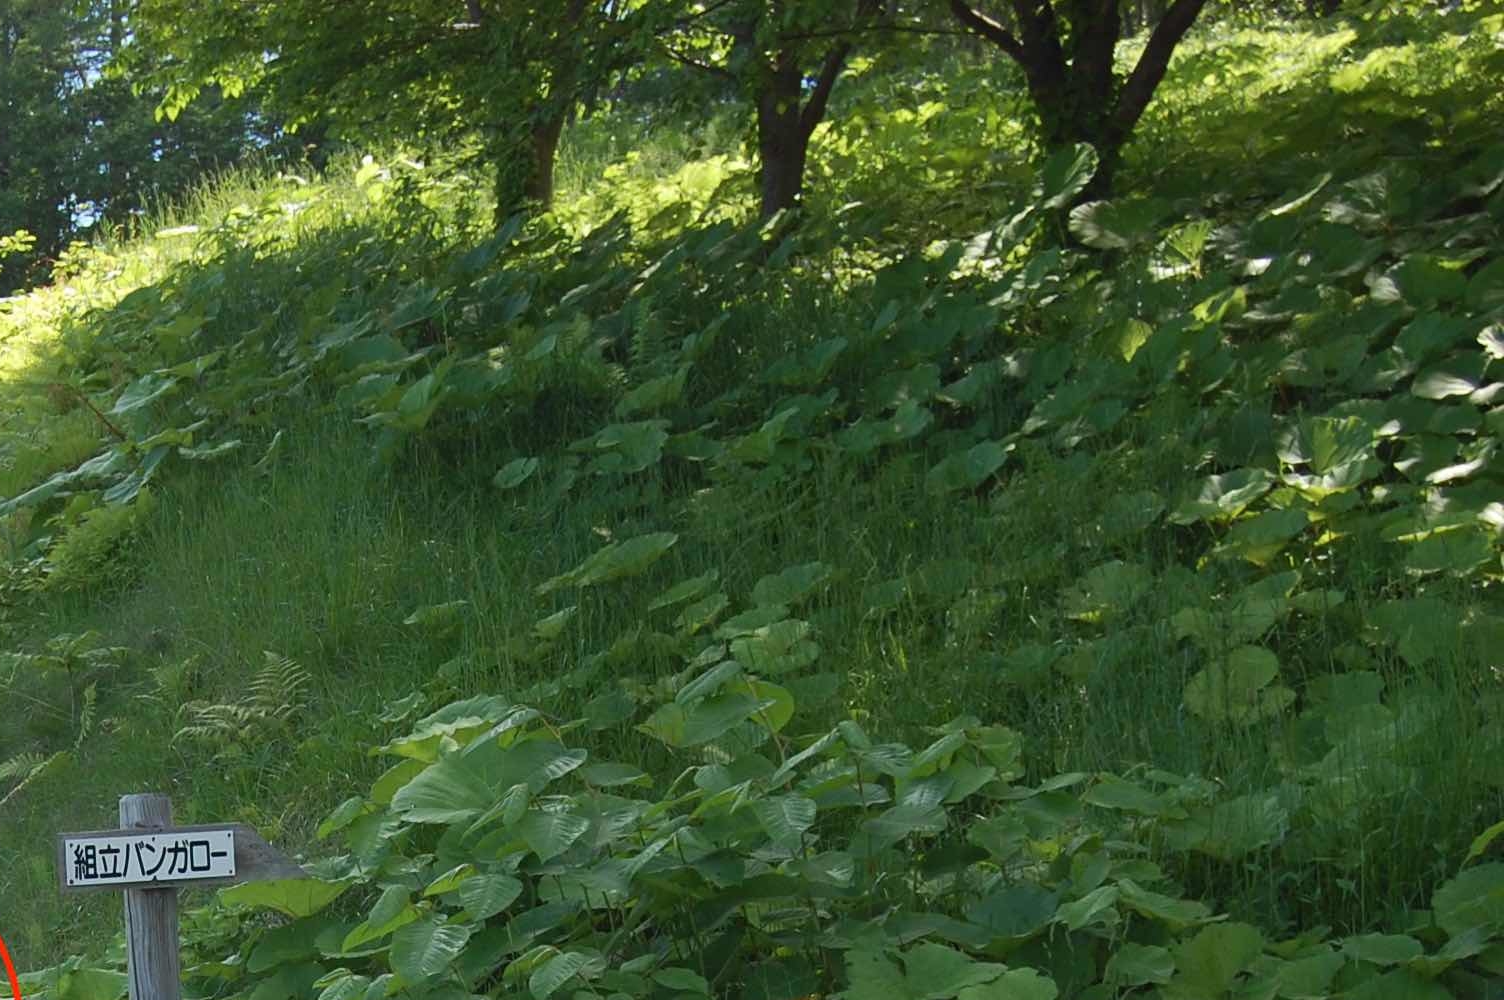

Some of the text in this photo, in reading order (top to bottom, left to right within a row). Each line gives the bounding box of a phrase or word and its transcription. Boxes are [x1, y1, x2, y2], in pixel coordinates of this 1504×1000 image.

[74, 840, 227, 880] 組立バンガロー
